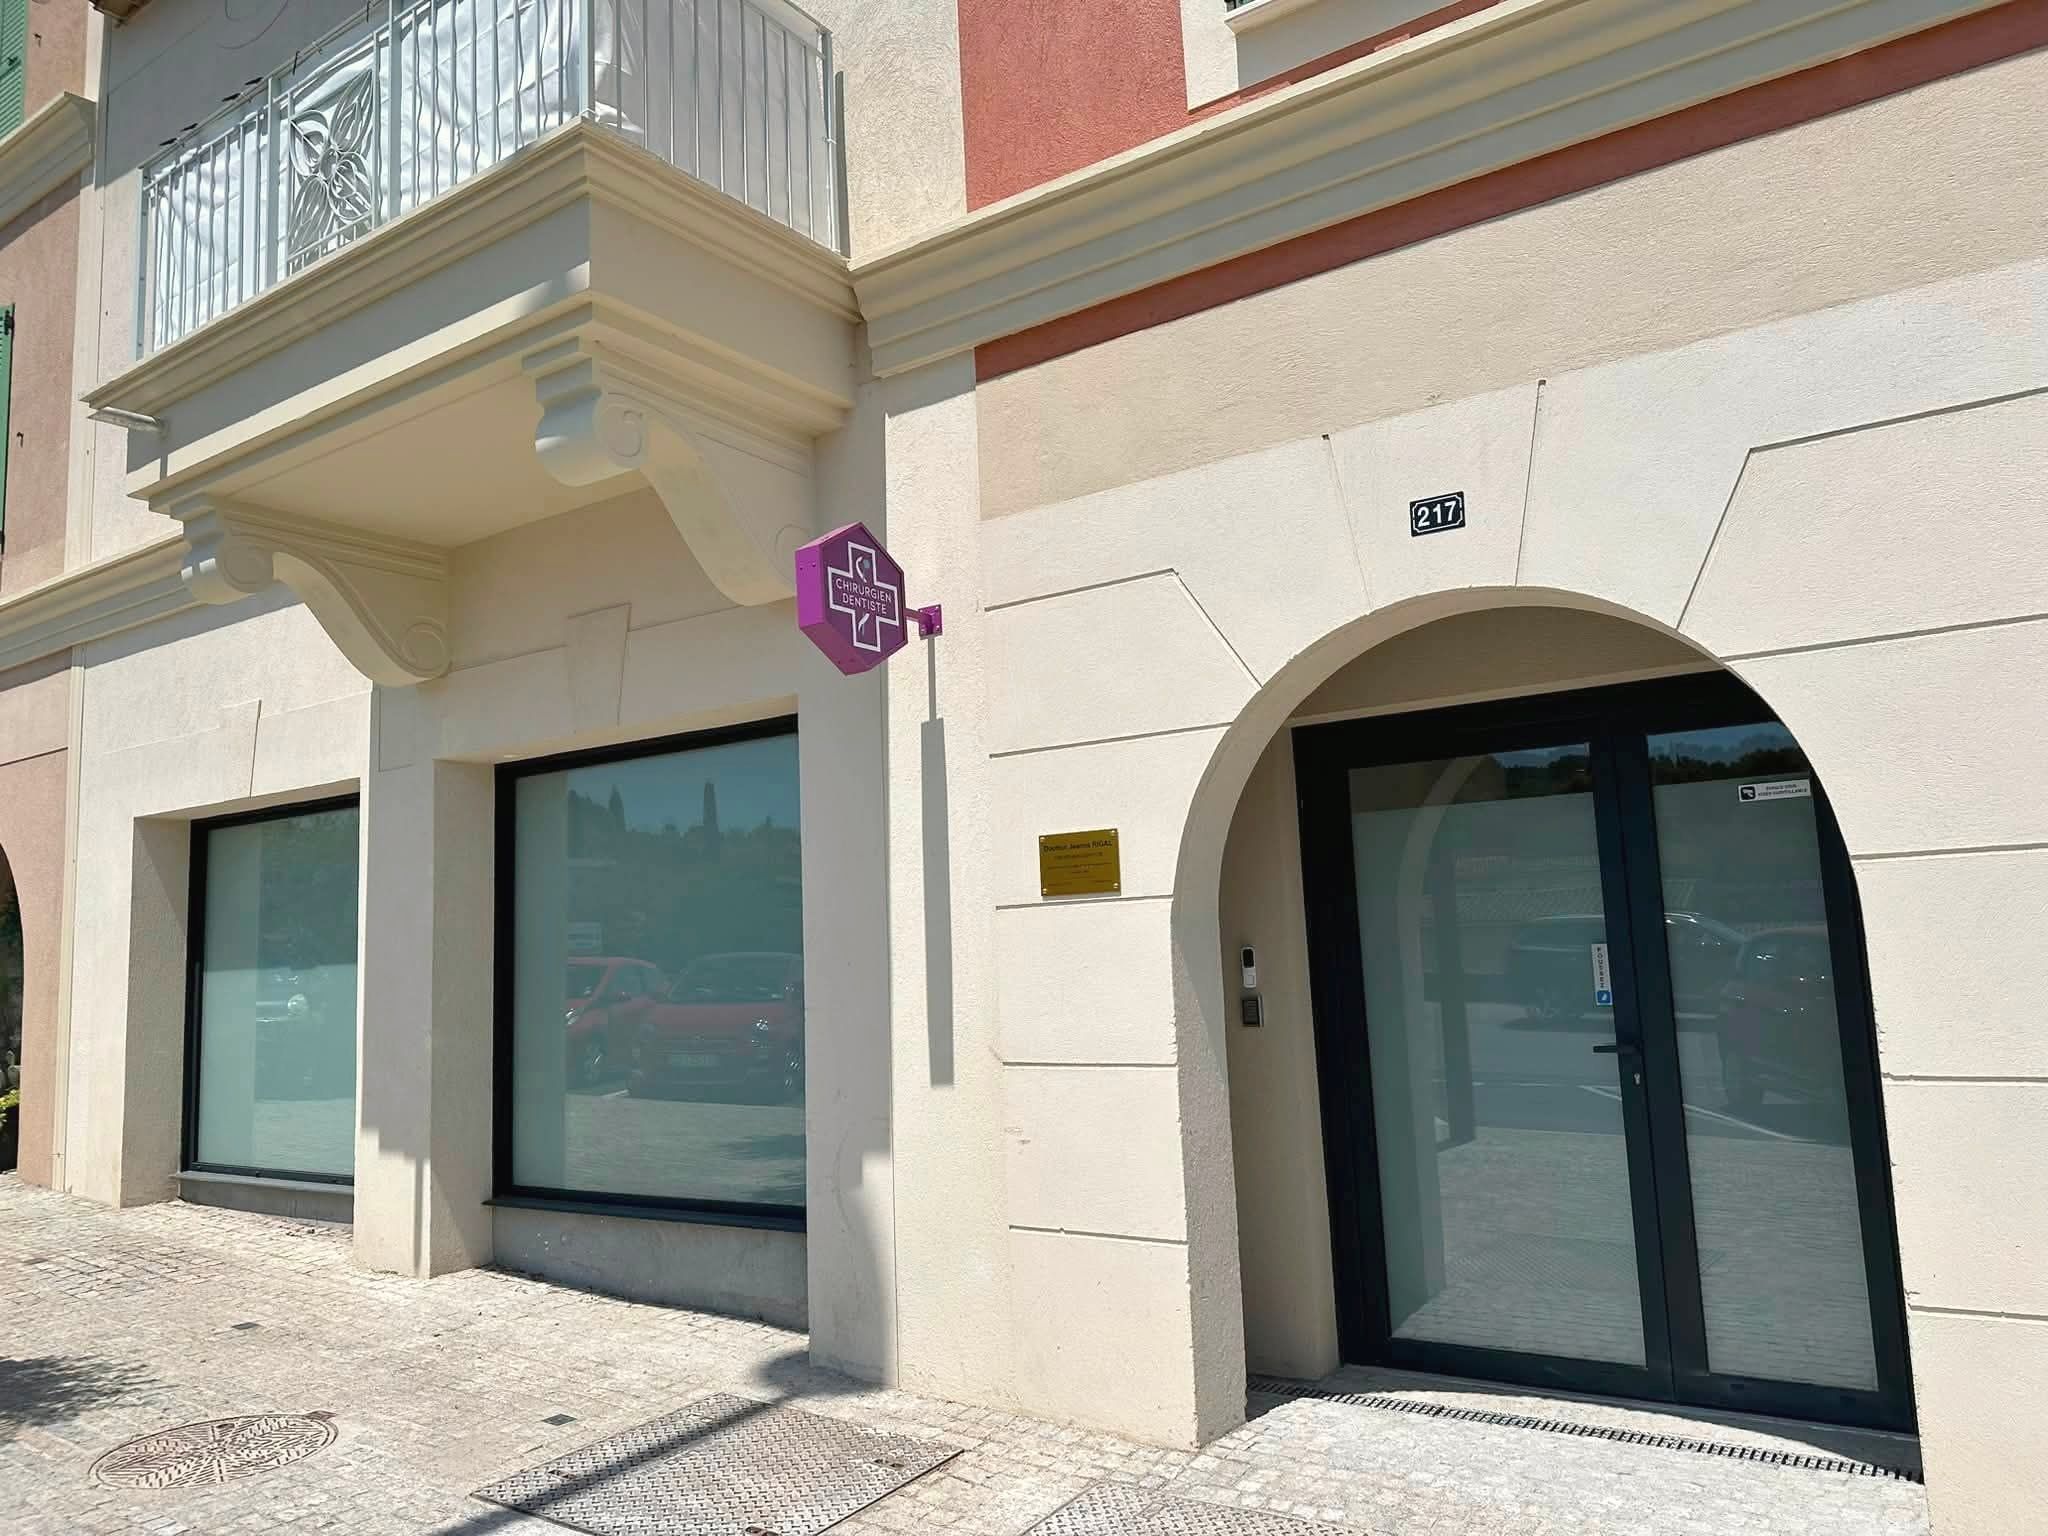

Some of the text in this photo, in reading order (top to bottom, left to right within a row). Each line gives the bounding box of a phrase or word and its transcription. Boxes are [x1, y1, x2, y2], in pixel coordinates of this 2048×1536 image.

[1418, 501, 1457, 527] 217
[835, 578, 892, 603] CHIRURGIEN
[842, 592, 887, 615] DENTISTE
